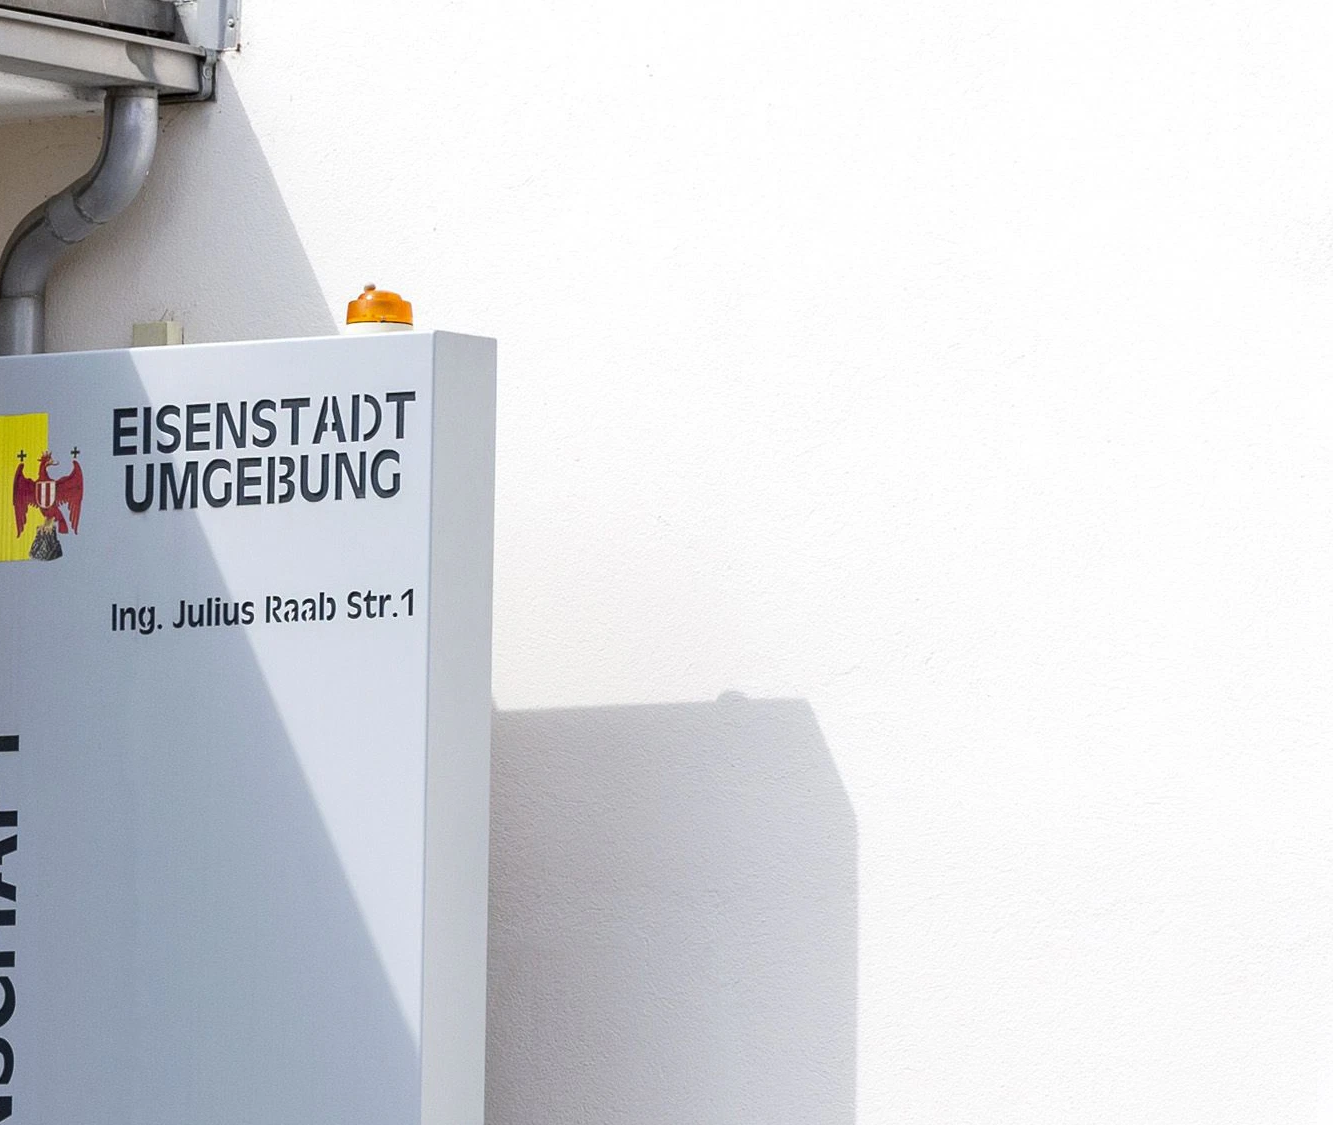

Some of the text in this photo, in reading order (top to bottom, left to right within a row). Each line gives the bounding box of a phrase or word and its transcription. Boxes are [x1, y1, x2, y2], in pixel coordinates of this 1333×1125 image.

[112, 391, 416, 456] EISENSTADT
[124, 449, 401, 513] UMGEBUNG
[111, 603, 163, 635] Ing.
[172, 597, 255, 629] Julius
[265, 592, 336, 624] Raab
